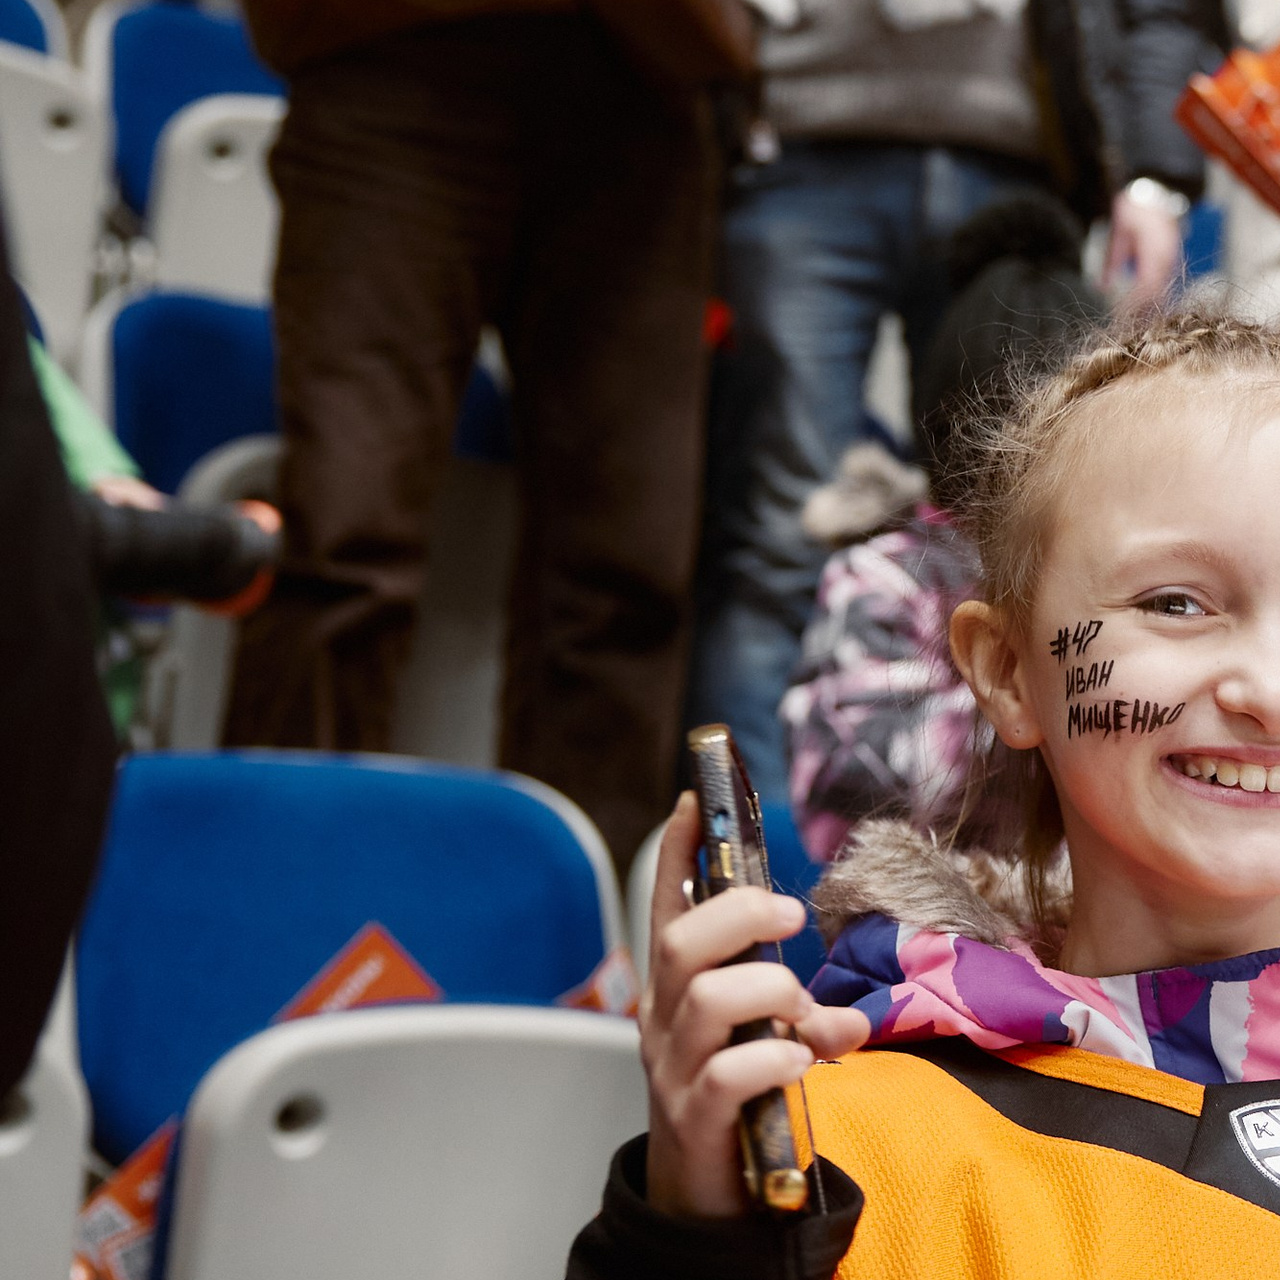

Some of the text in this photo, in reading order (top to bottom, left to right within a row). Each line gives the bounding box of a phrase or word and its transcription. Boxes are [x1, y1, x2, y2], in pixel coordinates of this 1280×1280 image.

[1049, 620, 1103, 665] #47
[1065, 659, 1114, 701] ИВАН
[1067, 698, 1186, 740] МИЩЕНКО
